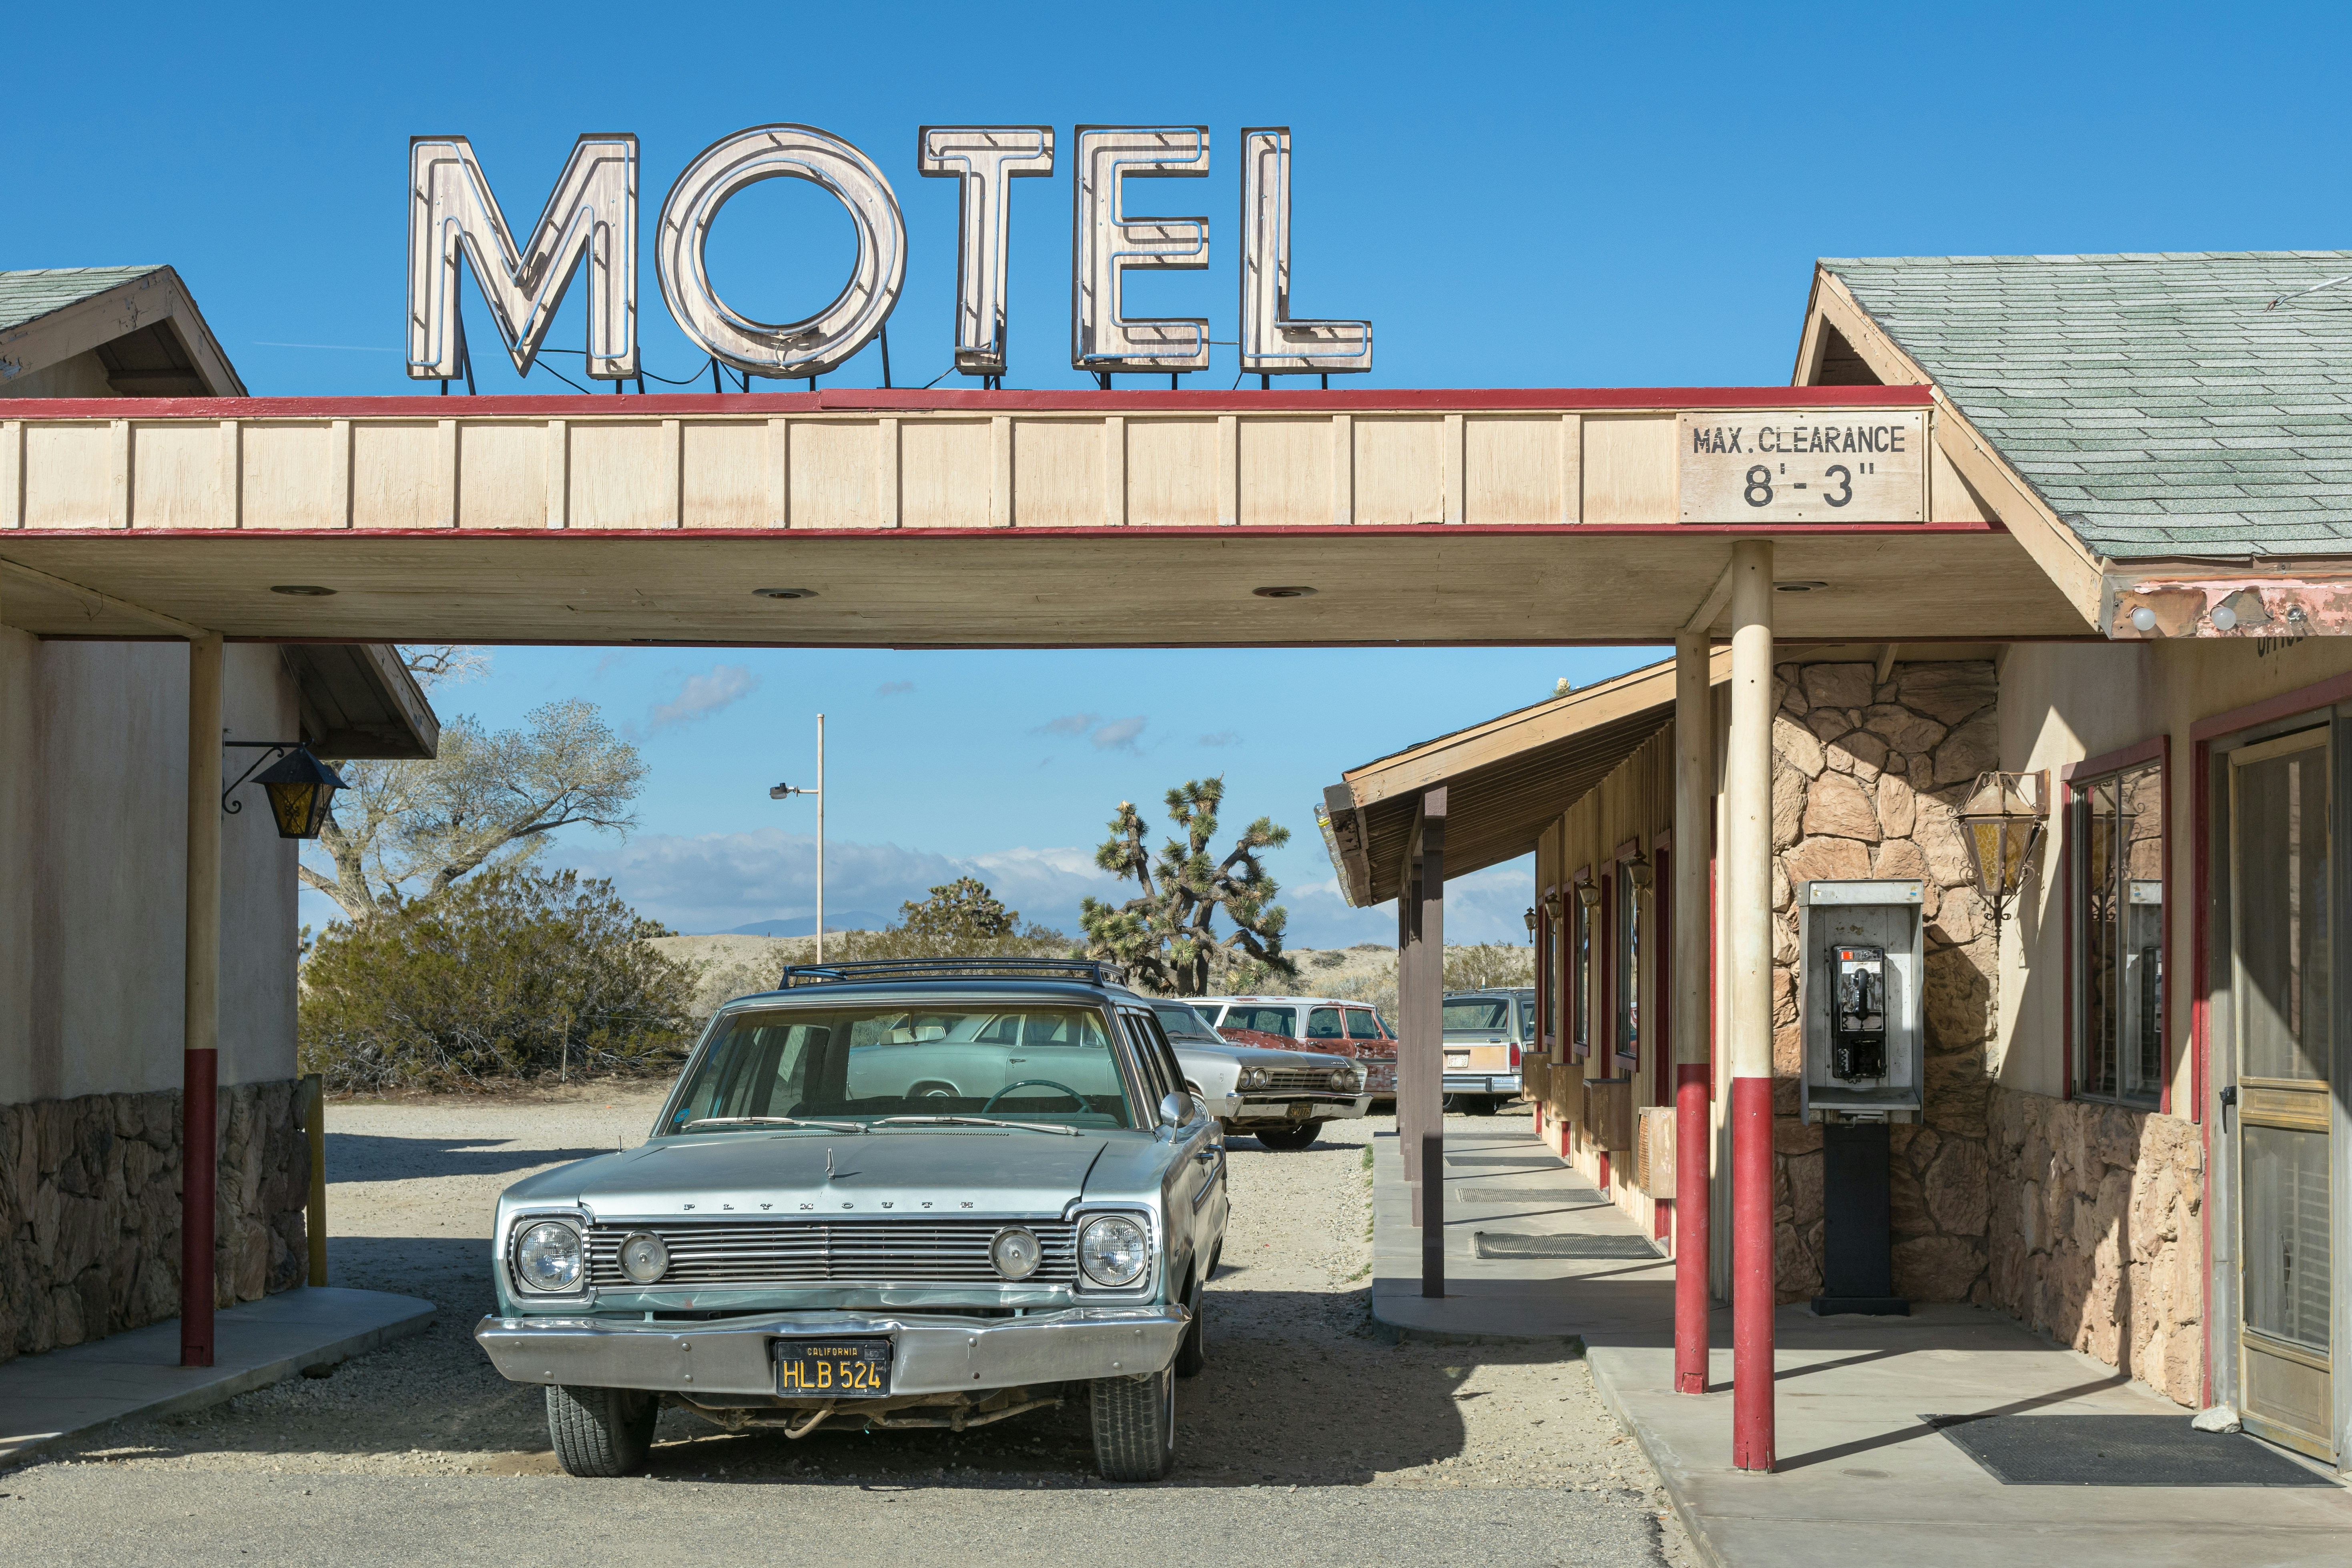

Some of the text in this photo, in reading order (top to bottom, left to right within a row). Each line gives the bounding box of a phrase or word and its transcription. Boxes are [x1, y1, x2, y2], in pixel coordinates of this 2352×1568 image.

[406, 122, 1373, 379] MOTEL
[1694, 426, 1905, 454] MAX. CLEARANCE
[684, 1201, 973, 1210] PLYMOUTH
[807, 1347, 858, 1356] CALIFORNIA
[783, 1360, 881, 1389] HLB 524
